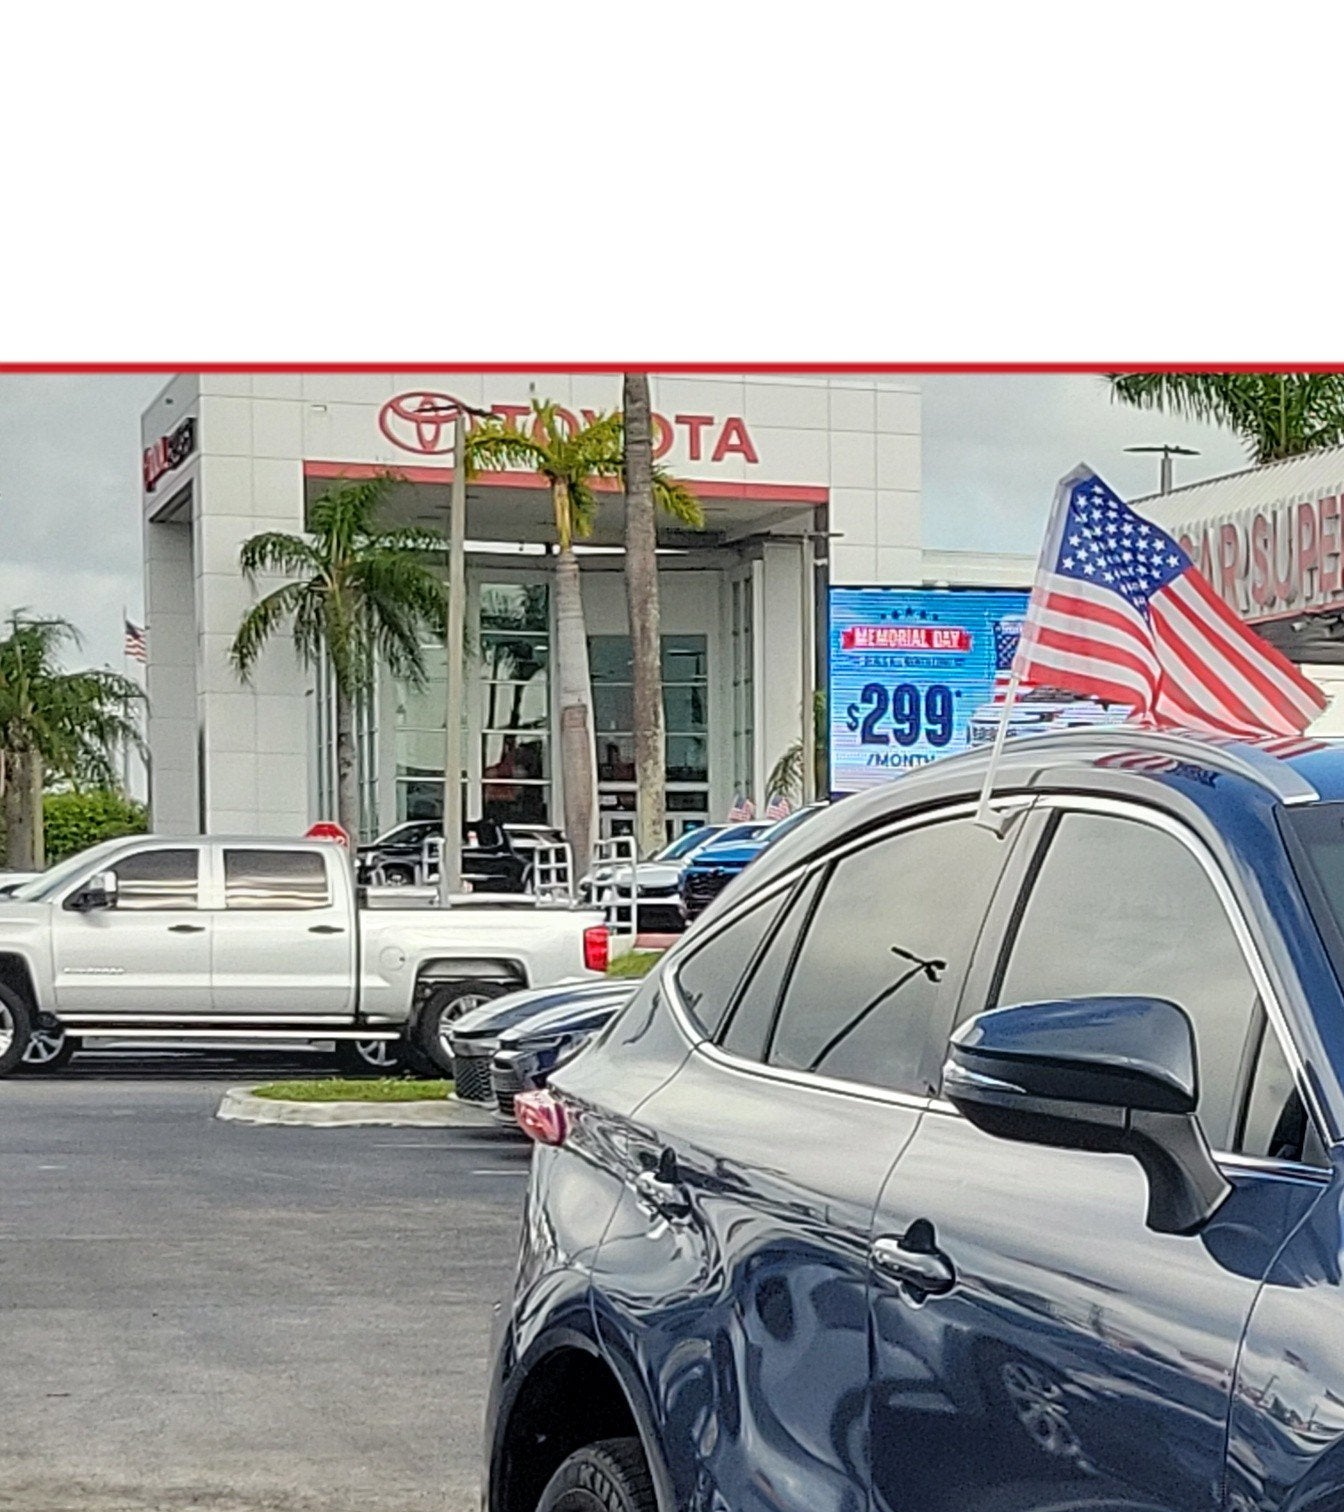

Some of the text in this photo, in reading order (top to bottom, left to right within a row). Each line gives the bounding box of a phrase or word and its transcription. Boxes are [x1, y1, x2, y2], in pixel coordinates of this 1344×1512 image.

[490, 403, 759, 464] TOOTA
[854, 627, 961, 649] MEMORIAL DAY
